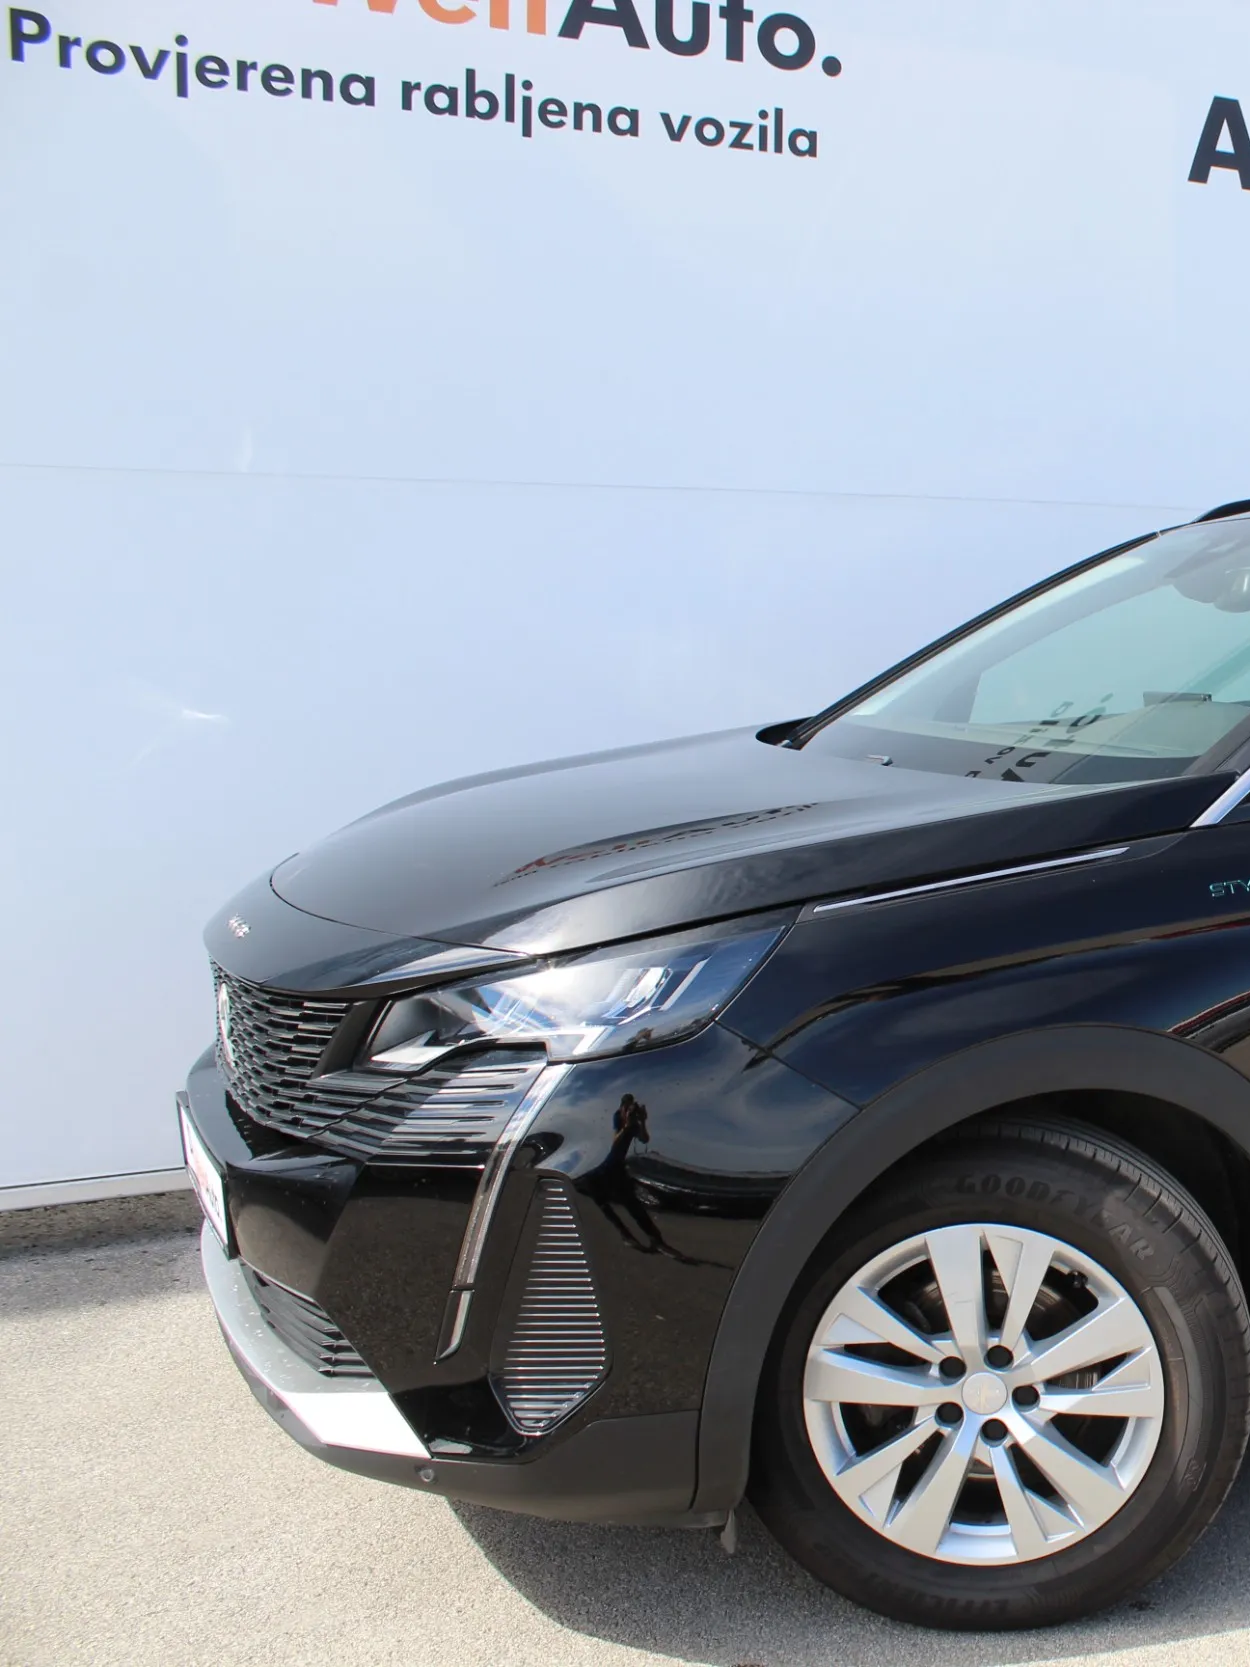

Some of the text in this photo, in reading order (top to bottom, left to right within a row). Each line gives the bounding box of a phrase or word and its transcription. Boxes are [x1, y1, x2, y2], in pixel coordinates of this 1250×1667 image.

[8, 6, 818, 158] Provjerena rabljena vozila
